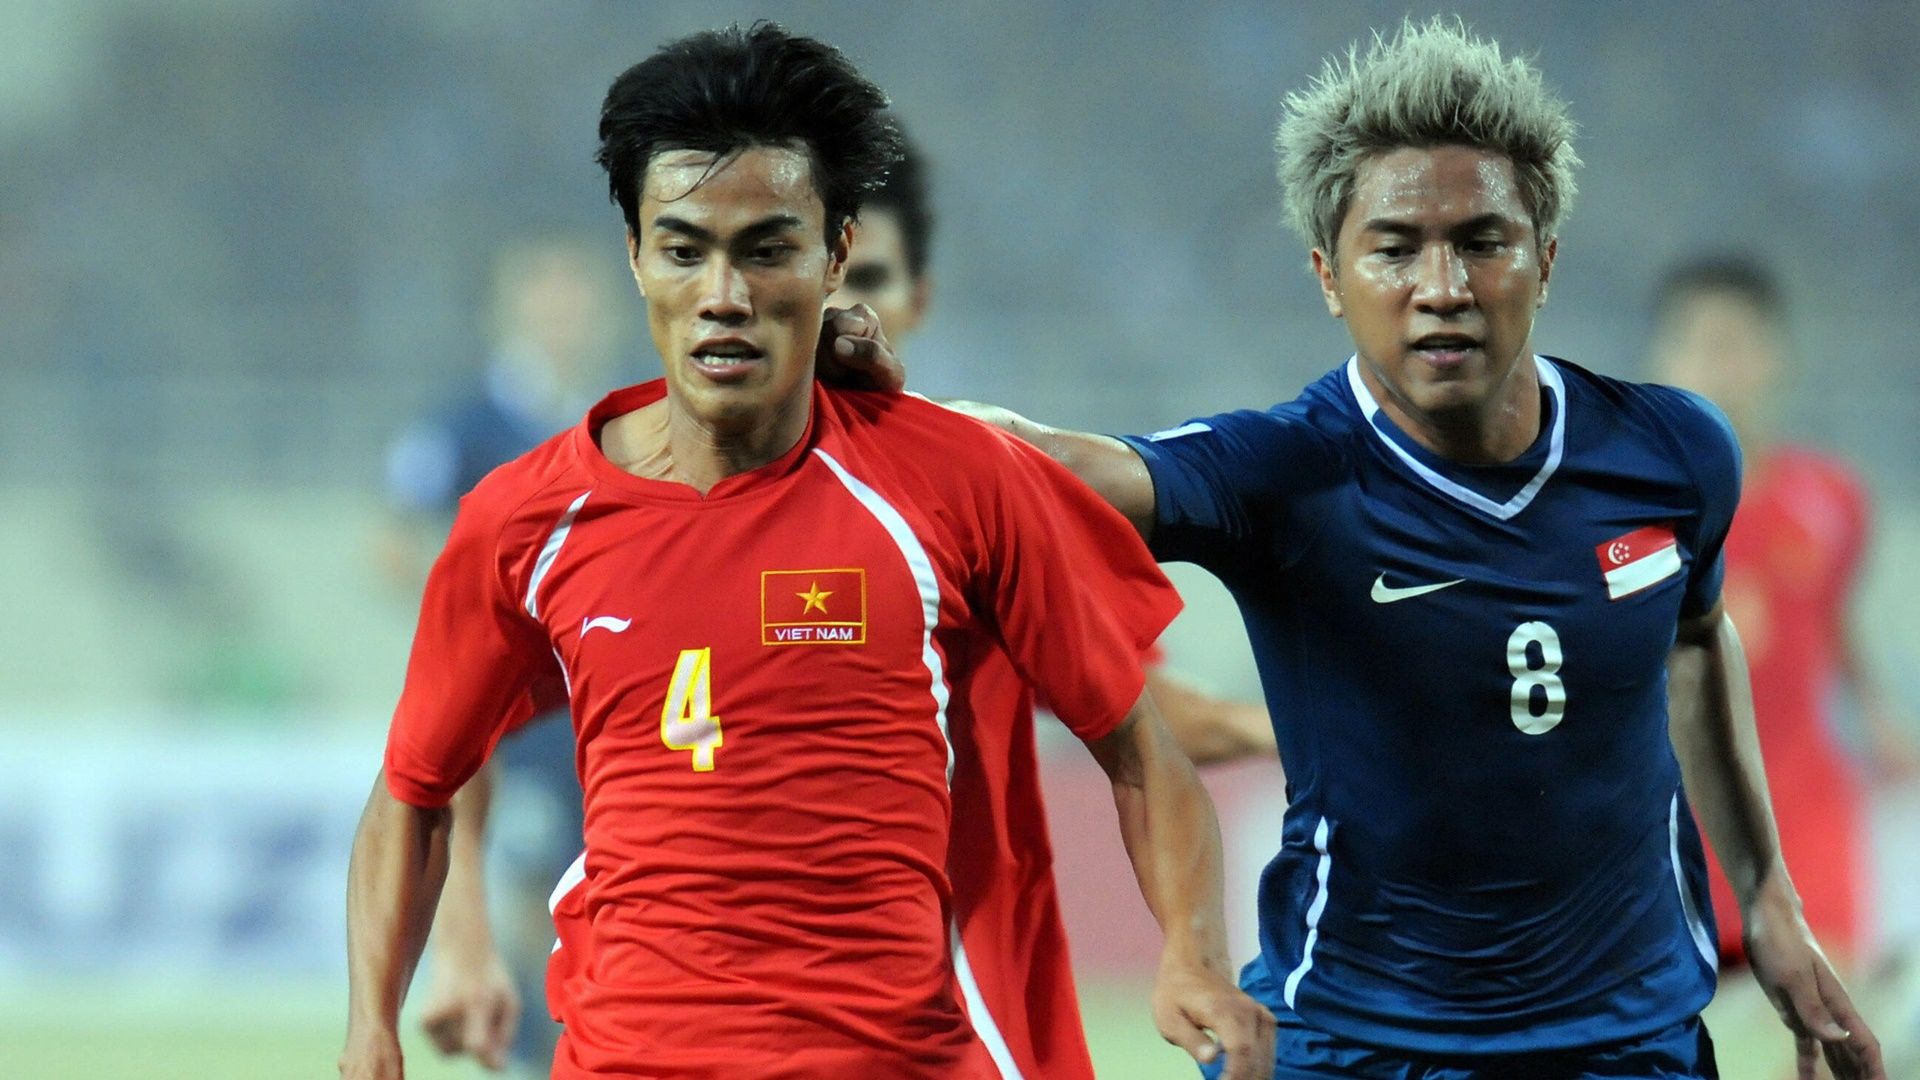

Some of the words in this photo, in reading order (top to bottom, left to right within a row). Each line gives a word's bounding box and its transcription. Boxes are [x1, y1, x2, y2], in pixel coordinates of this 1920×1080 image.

[774, 627, 812, 641] VIET
[815, 627, 854, 641] NAM
[1507, 621, 1566, 735] 8
[660, 647, 723, 772] 4
